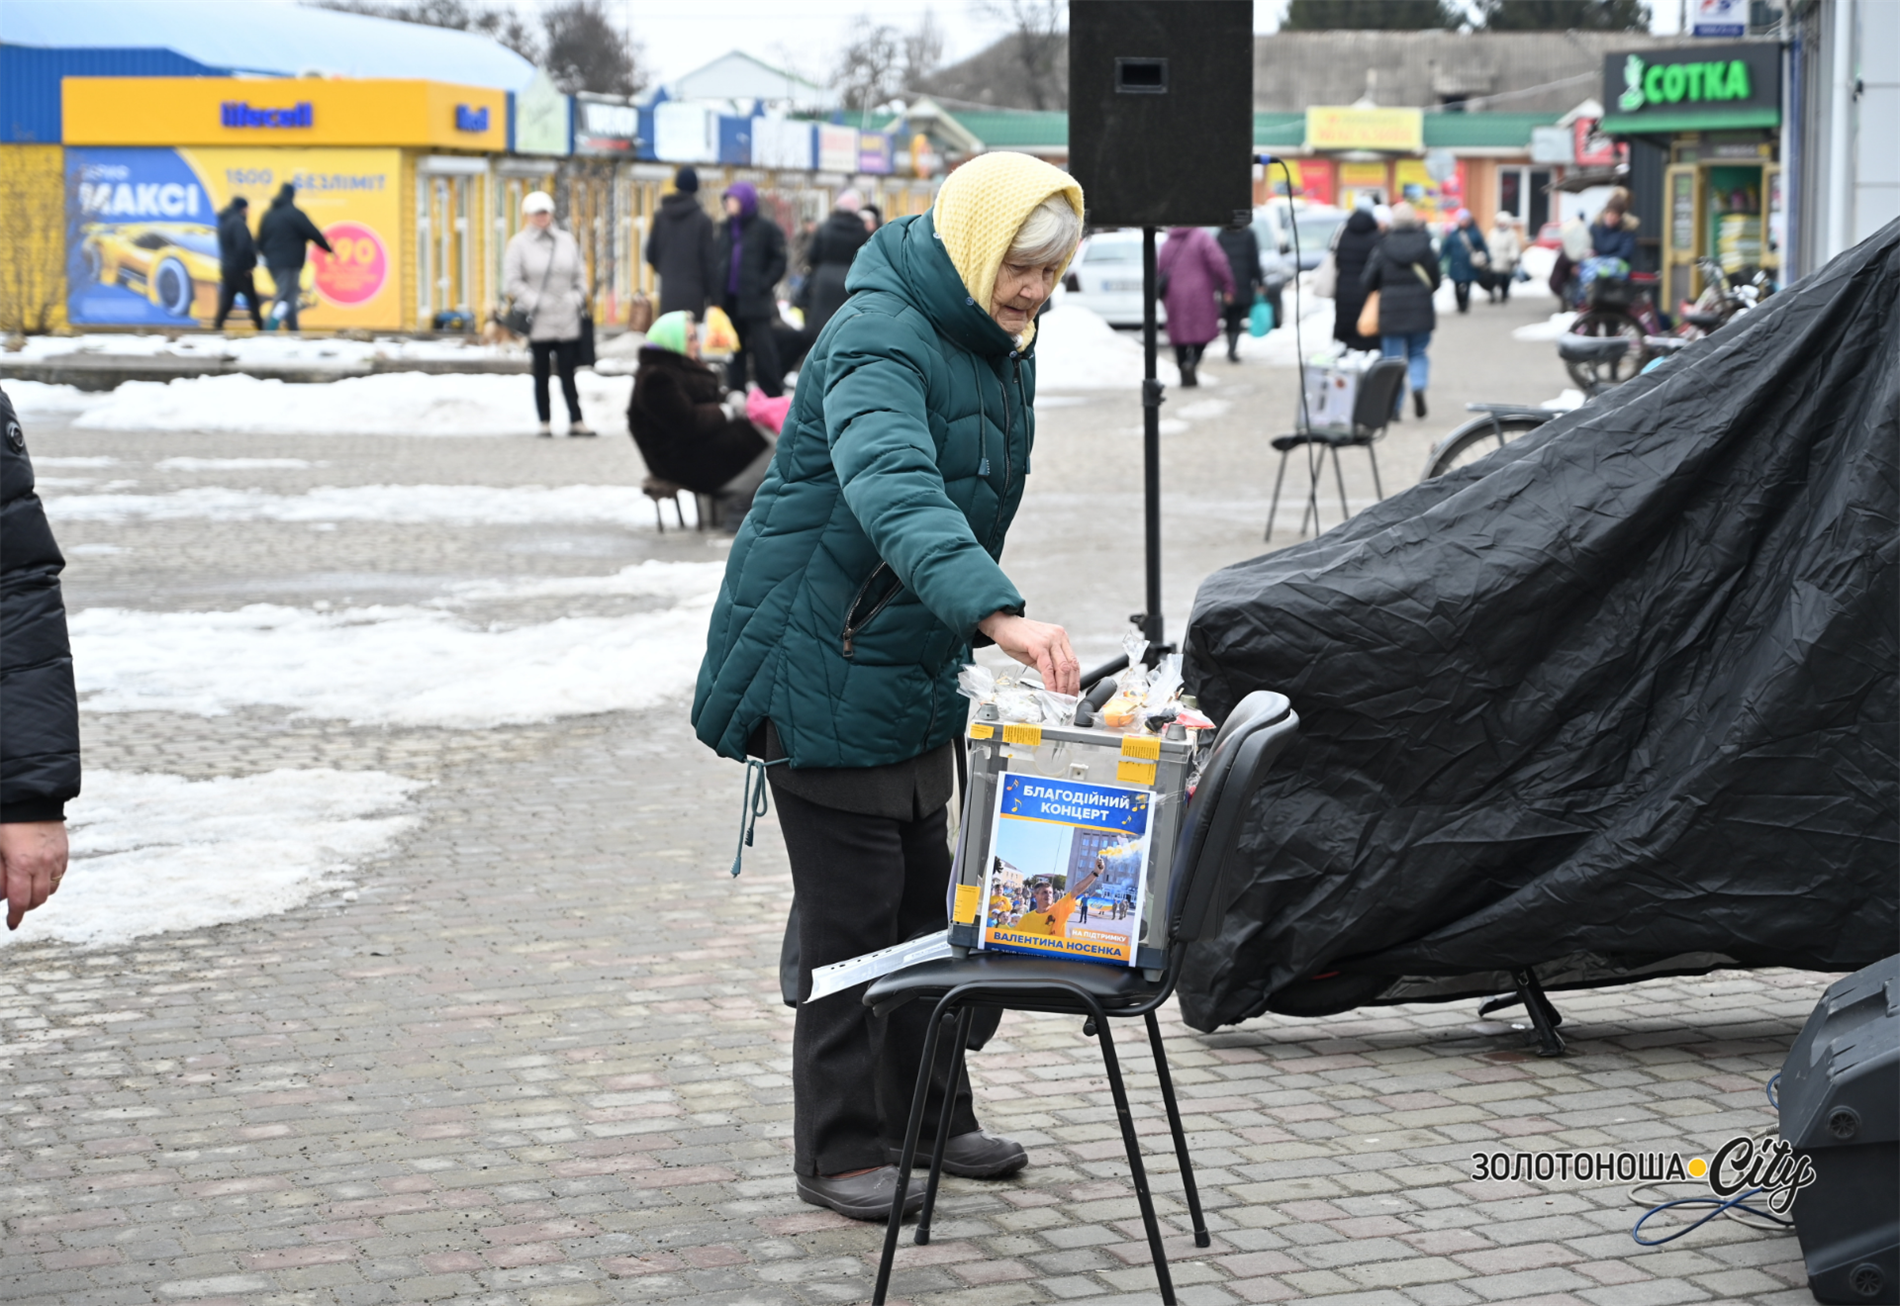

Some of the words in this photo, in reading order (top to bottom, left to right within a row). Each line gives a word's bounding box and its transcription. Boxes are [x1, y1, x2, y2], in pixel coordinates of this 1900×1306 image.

[1645, 60, 1750, 103] СОТКА
[79, 182, 199, 217] МАКСІ
[1023, 785, 1130, 810] БЛАГОДІЙНИЙ
[1040, 802, 1109, 822] КОНЦЕРТ
[993, 931, 1064, 949] ВАЛЕНТИНА
[1066, 941, 1122, 957] НОСЕНКА
[1072, 929, 1083, 937] НА
[1083, 931, 1127, 942] ПІДТРИМКУ
